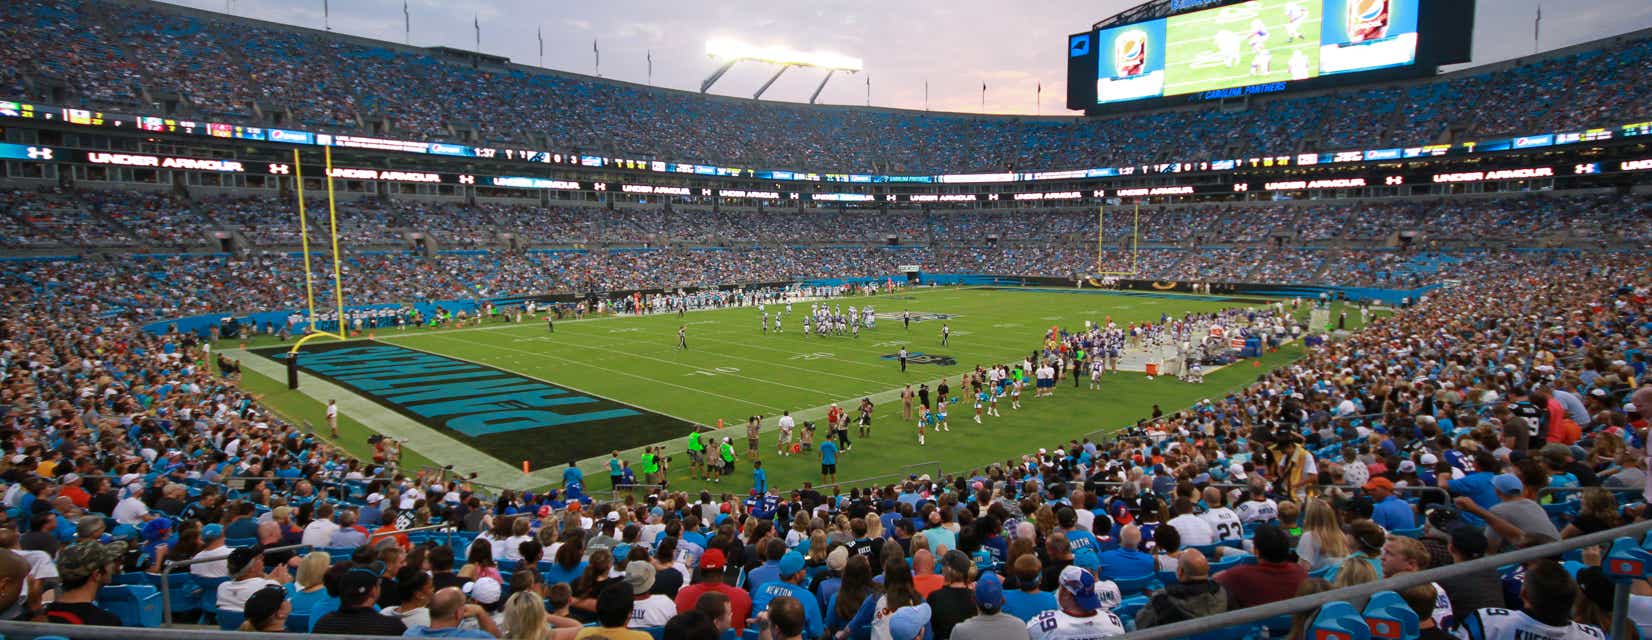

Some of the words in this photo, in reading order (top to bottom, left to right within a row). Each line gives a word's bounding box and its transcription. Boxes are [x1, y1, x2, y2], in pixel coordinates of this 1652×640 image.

[474, 148, 496, 158] 1:37
[88, 152, 158, 167] UNDER
[326, 168, 377, 179] UNDER
[1118, 166, 1135, 175] 1:37
[1433, 172, 1483, 182] UNDER
[1264, 181, 1306, 191] UNDER
